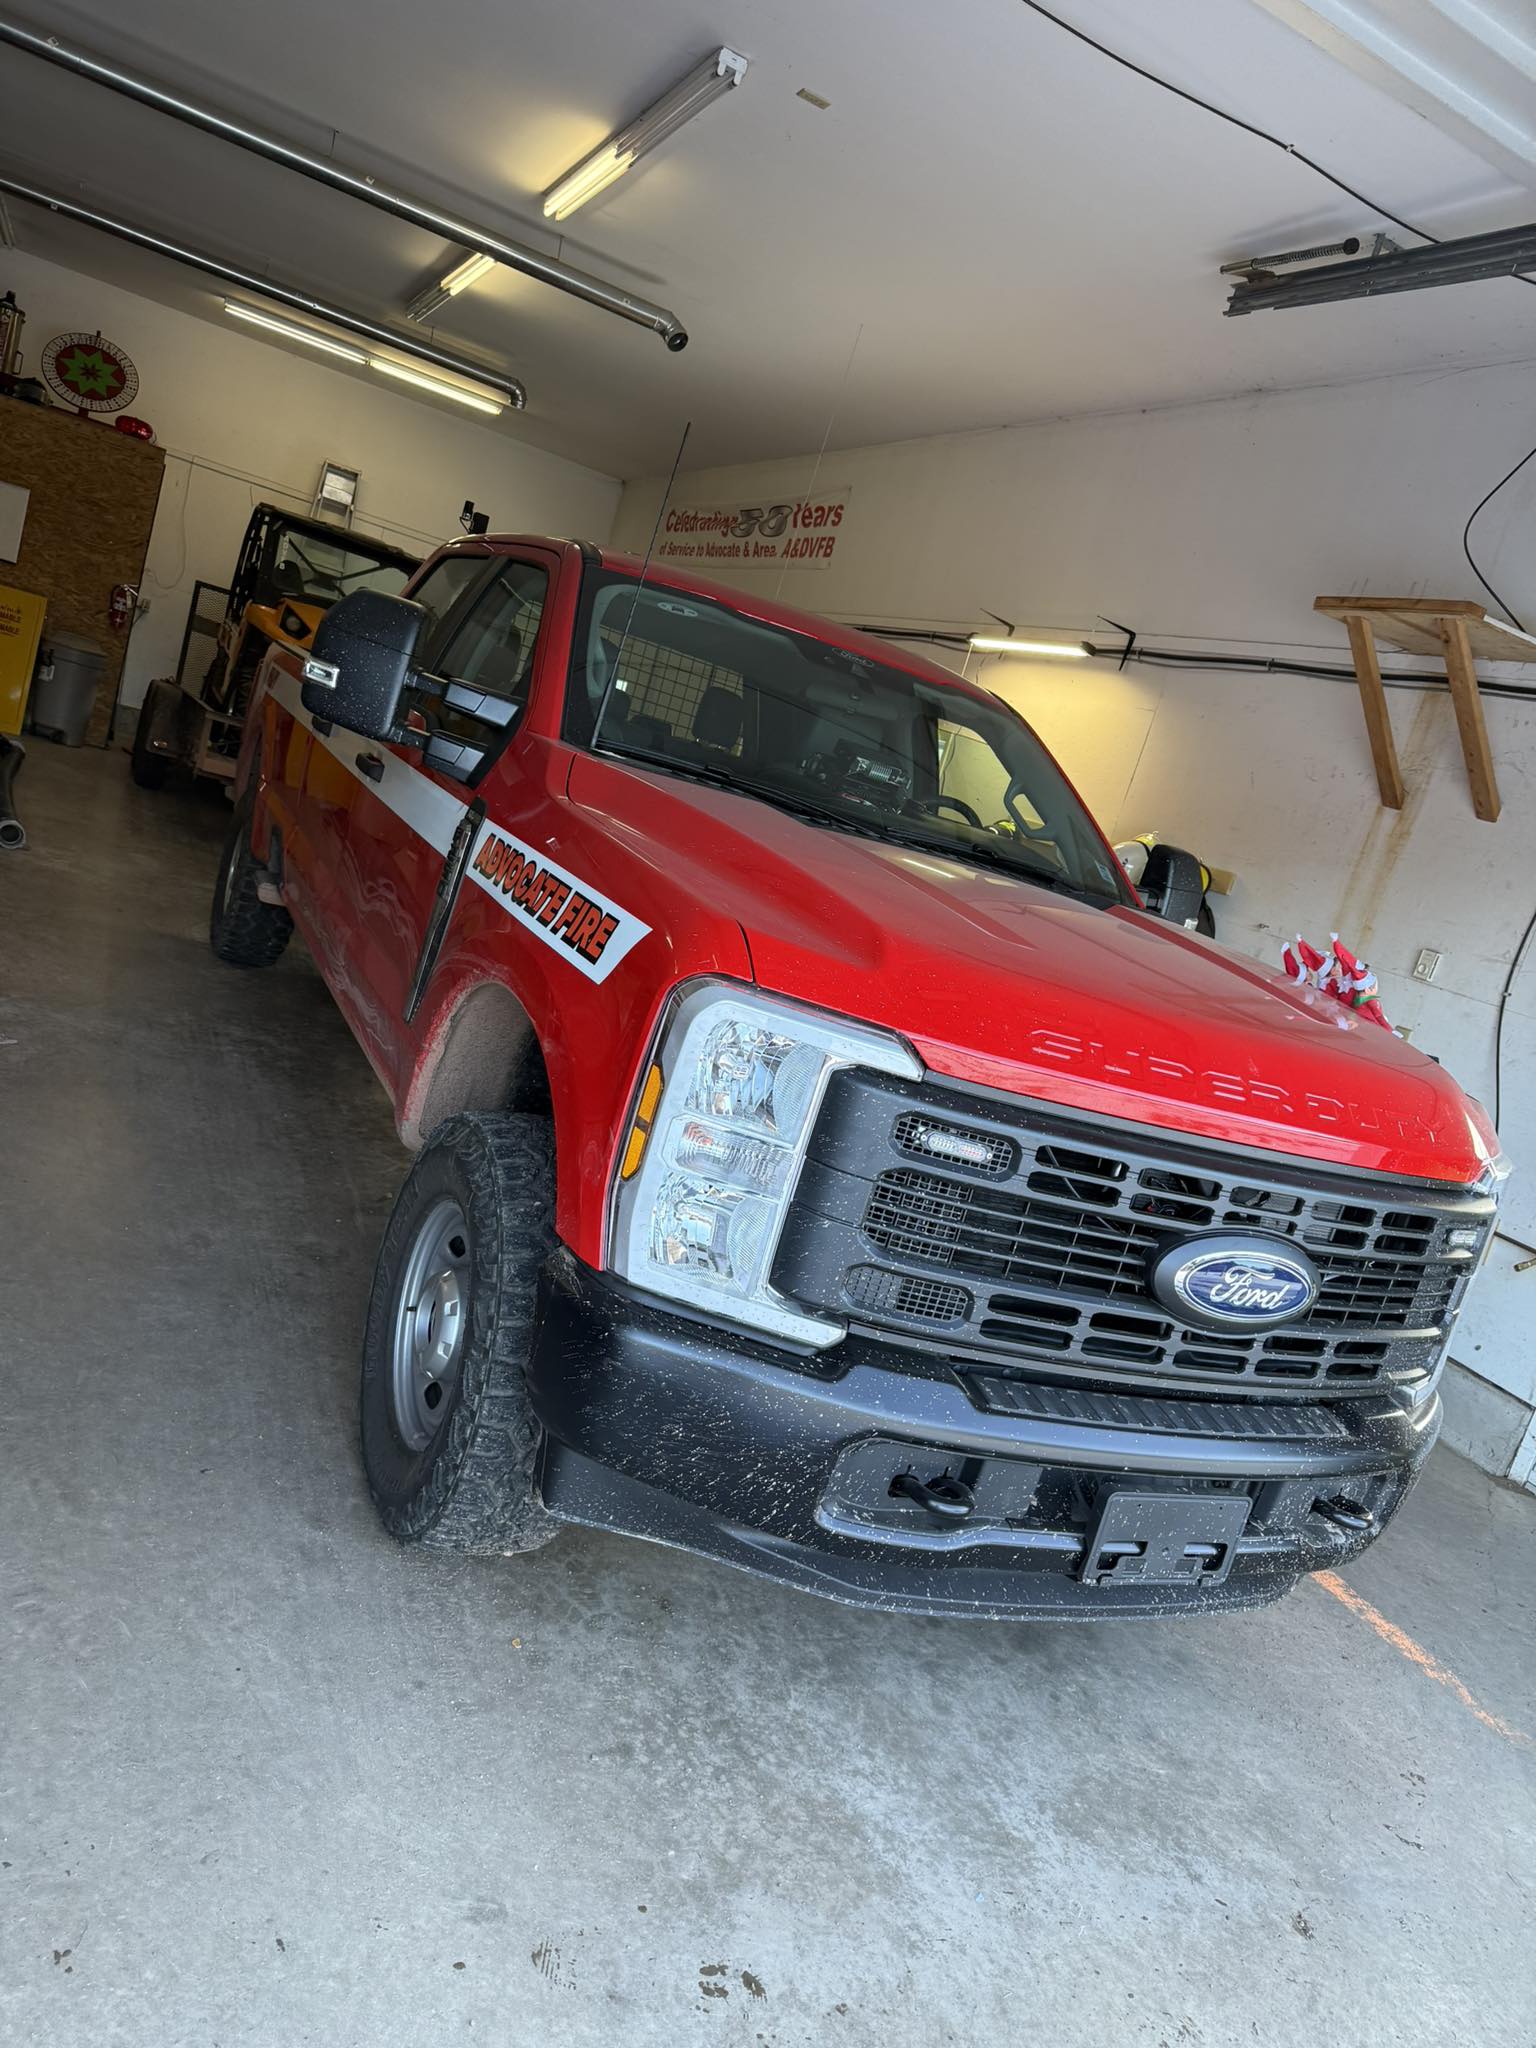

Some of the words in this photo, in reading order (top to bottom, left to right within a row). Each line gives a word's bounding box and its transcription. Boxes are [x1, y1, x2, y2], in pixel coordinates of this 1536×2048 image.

[730, 504, 793, 538] 50
[792, 502, 844, 529] Years
[667, 542, 696, 557] Service
[696, 544, 704, 557] to
[705, 542, 741, 558] Advocate
[743, 542, 750, 557] &
[781, 536, 836, 559] A&DVFB
[472, 833, 572, 928] ADVOCATE
[550, 891, 621, 966] FIRE
[1030, 1028, 1294, 1113] SUPER
[1304, 1091, 1447, 1143] DUTY
[1209, 1265, 1296, 1310] Ford
